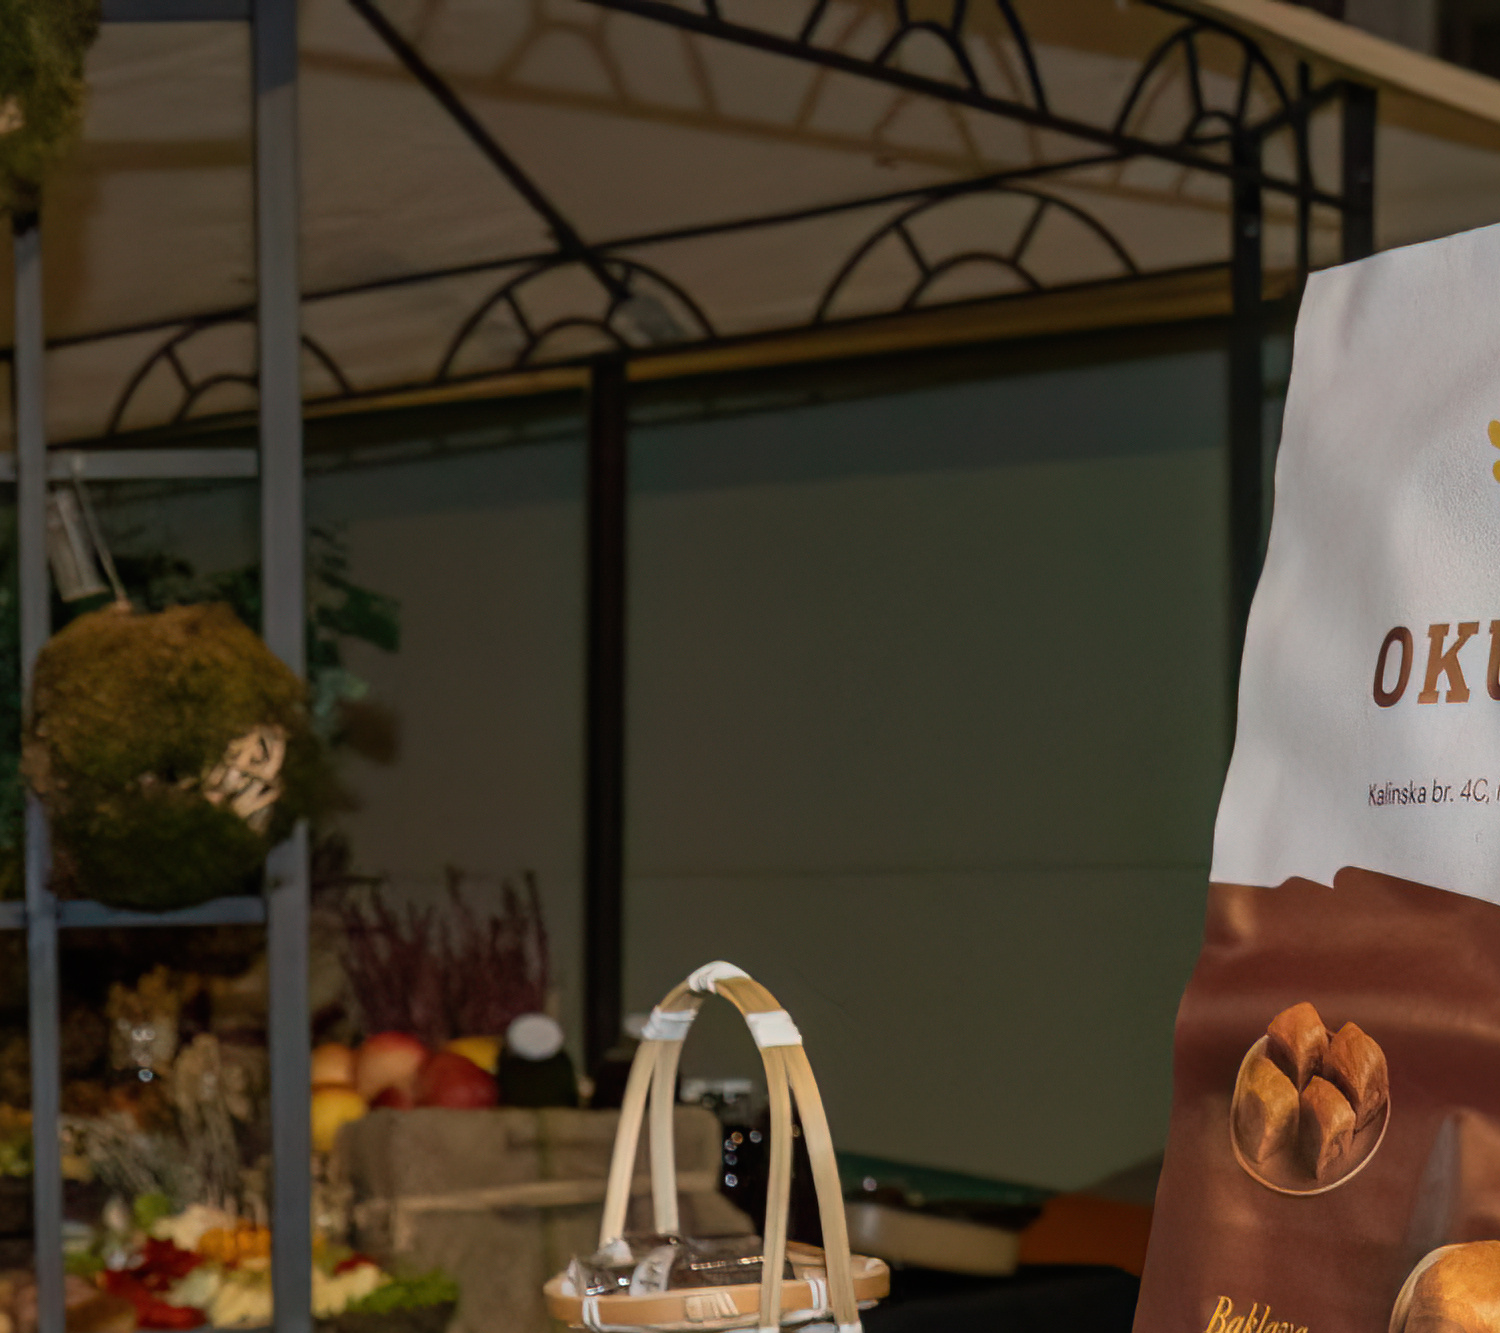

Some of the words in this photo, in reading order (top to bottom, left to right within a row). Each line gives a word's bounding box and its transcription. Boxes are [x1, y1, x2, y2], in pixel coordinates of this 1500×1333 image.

[1368, 781, 1427, 807] Kalinska
[1431, 780, 1454, 803] br.
[1460, 778, 1490, 805] 4C,
